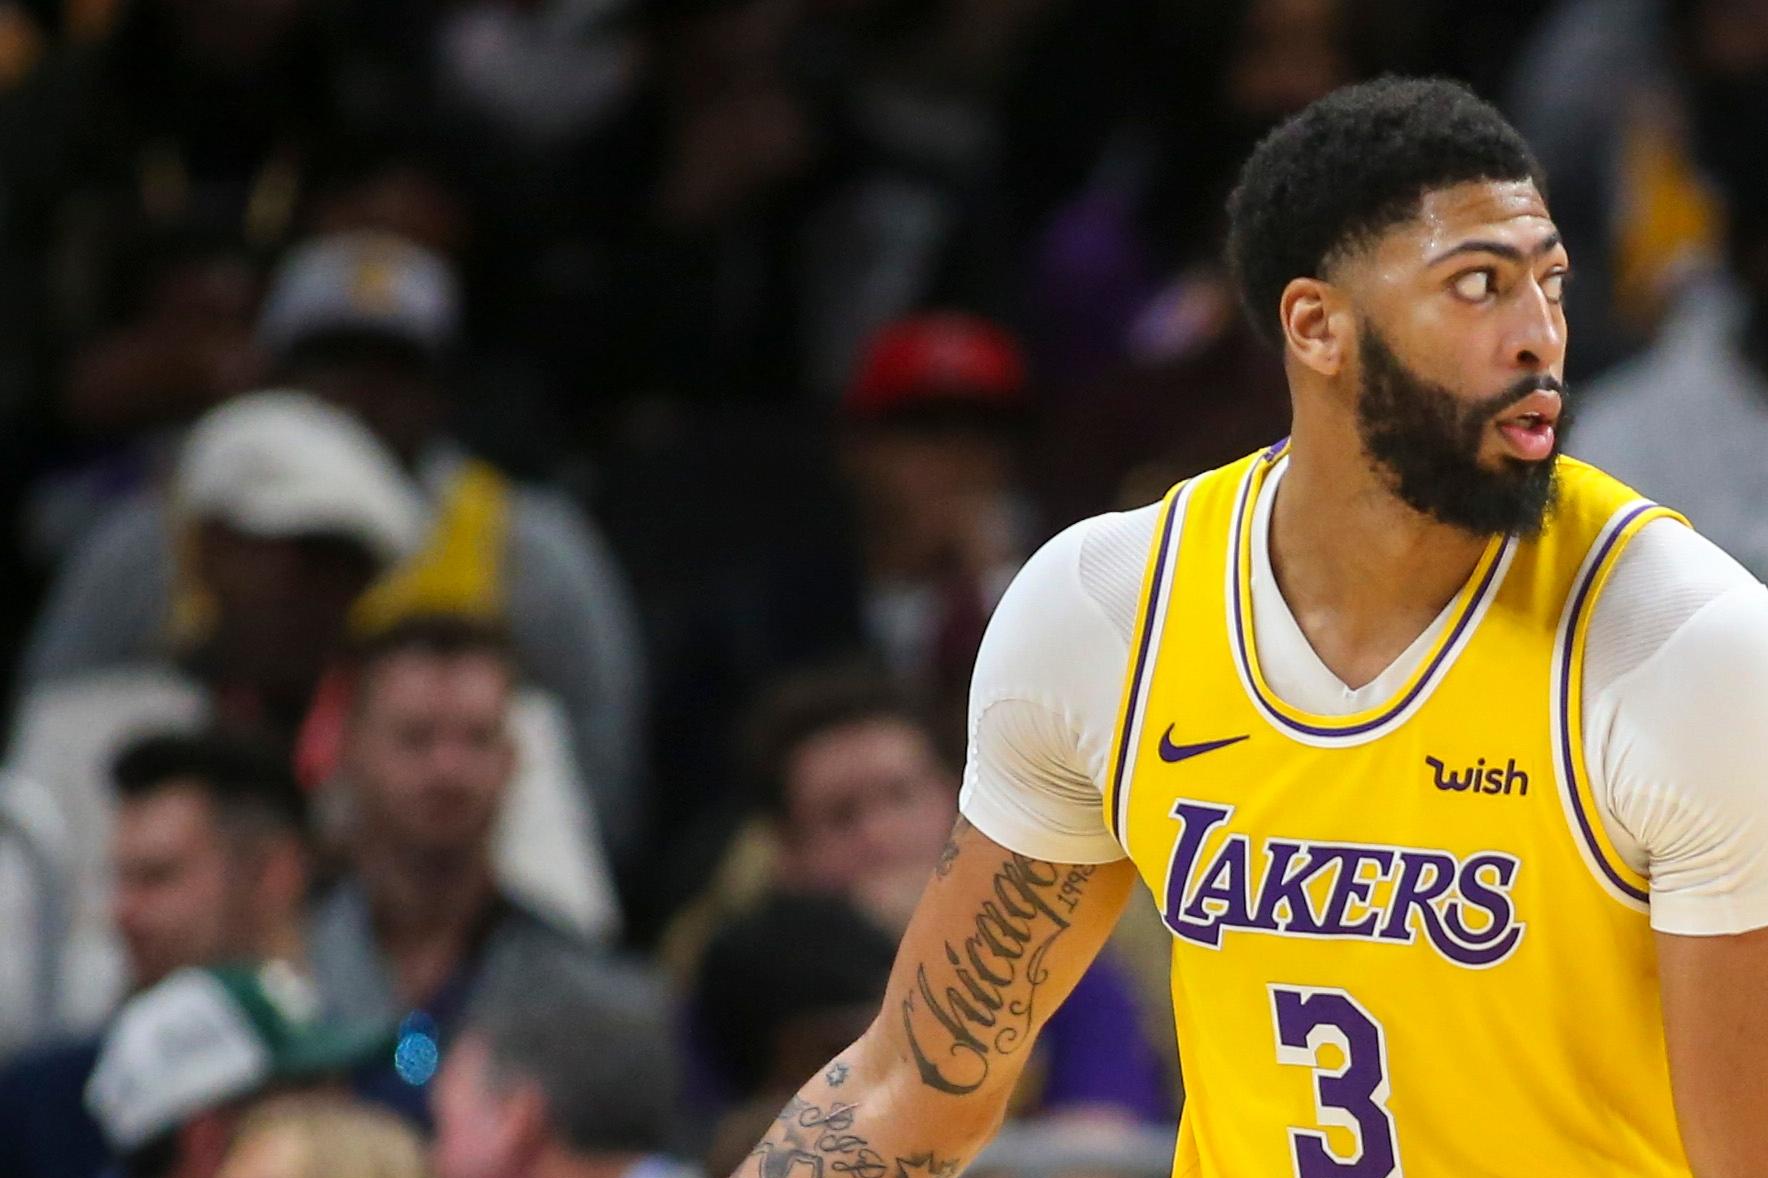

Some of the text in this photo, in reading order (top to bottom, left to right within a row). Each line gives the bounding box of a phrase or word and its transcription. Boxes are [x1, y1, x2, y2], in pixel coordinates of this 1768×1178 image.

[1426, 756, 1528, 795] wish
[1163, 797, 1526, 969] LAKERS
[904, 853, 1070, 1094] Chicago
